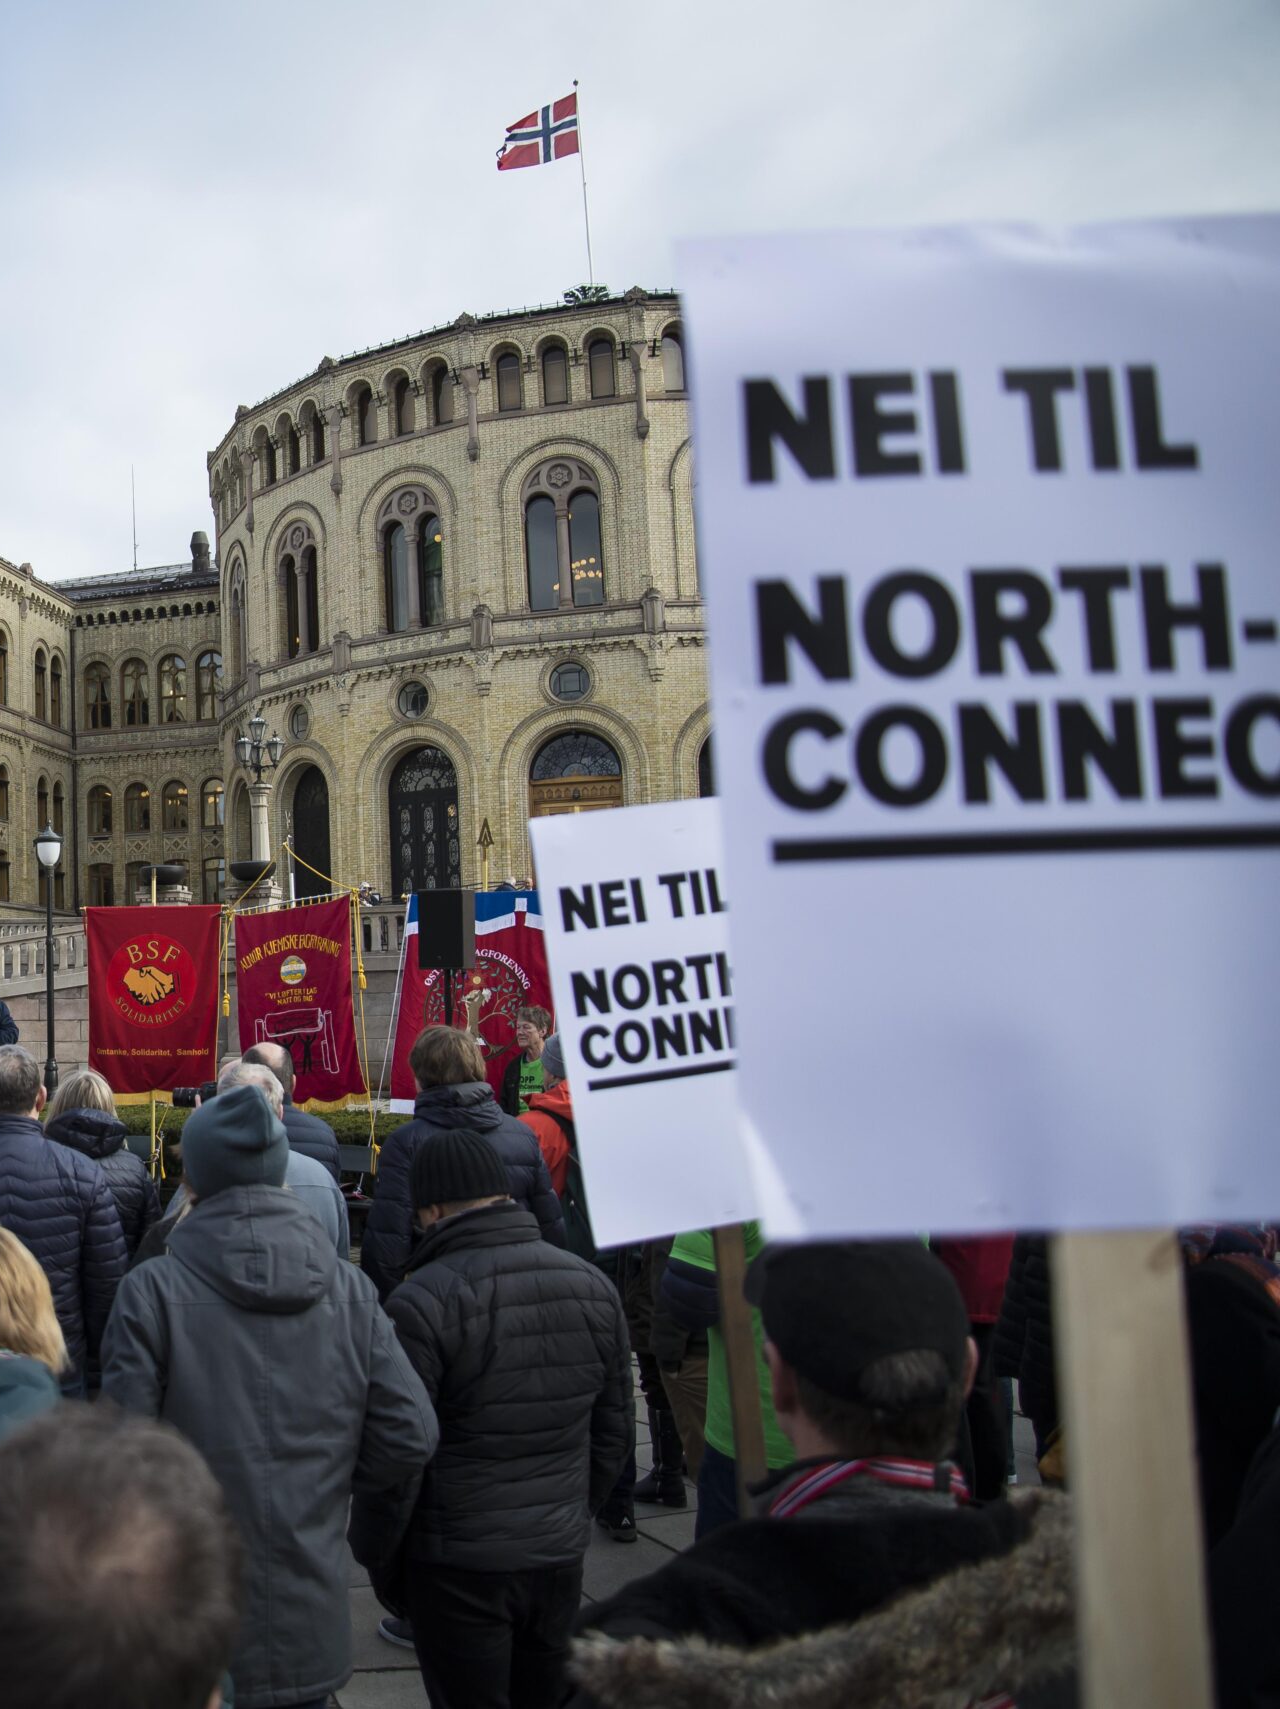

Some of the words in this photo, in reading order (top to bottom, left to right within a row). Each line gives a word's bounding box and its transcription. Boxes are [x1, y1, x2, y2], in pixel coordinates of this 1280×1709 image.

[741, 367, 968, 484] NEI
[1001, 363, 1200, 475] TIL
[753, 562, 1279, 686] NORTH-
[761, 692, 1280, 812] CONNEC
[558, 877, 648, 933] NEI
[658, 868, 727, 918] TIL
[126, 940, 180, 964] BSF
[475, 948, 531, 990] AGFORENING
[115, 996, 186, 1024] SOLIDARITET
[177, 1047, 209, 1056] Samhold
